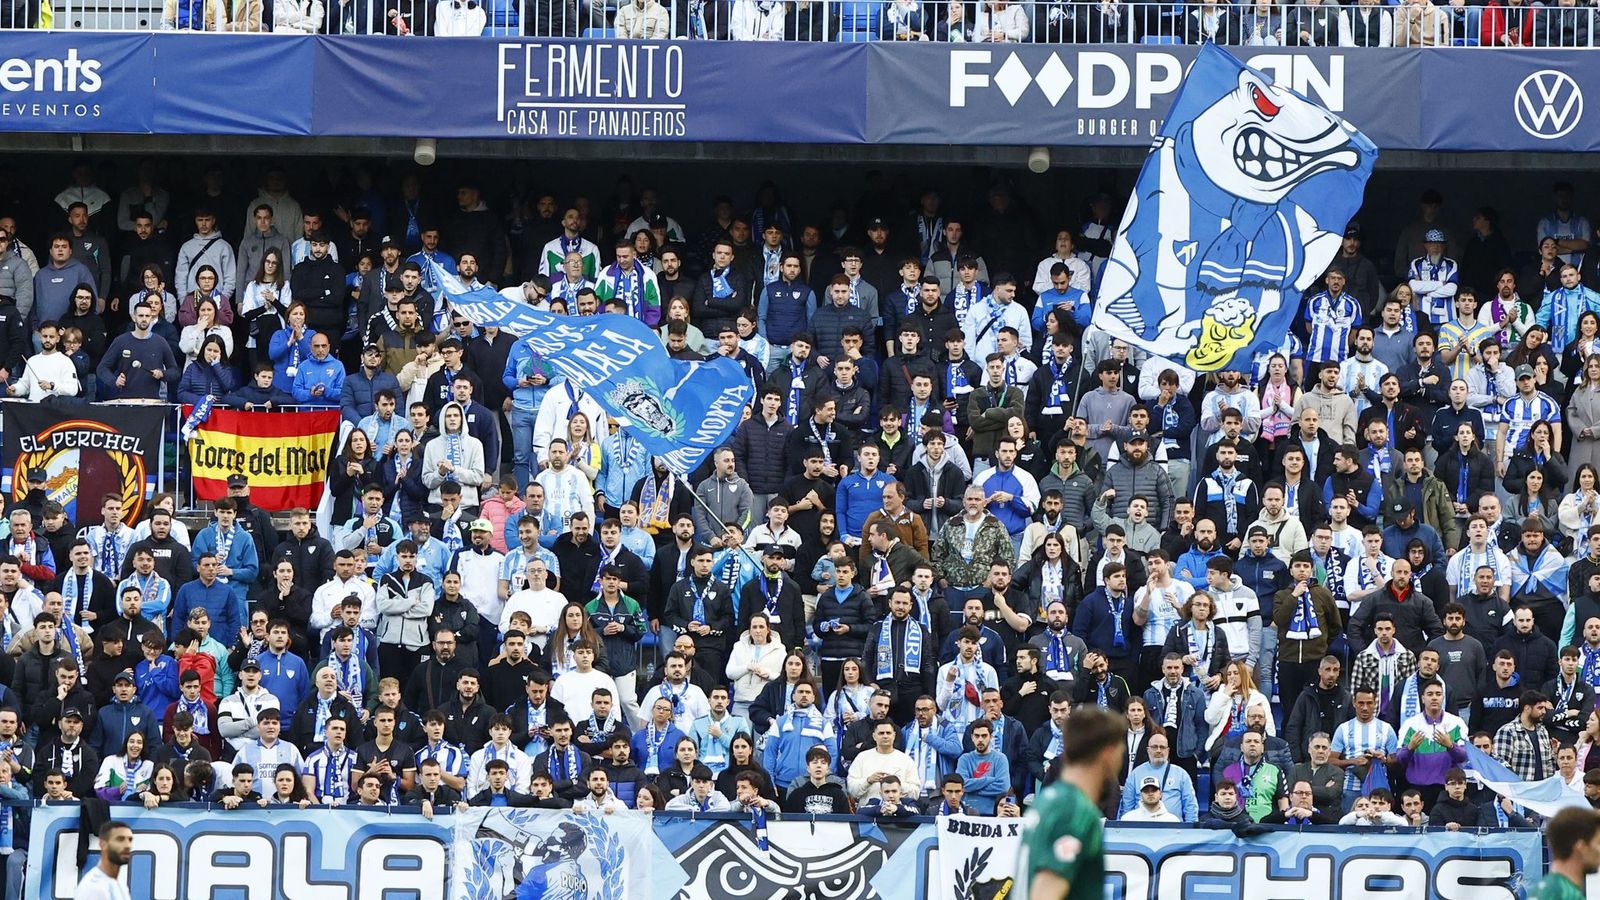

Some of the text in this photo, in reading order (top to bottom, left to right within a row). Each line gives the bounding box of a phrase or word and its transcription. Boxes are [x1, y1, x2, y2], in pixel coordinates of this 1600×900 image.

[0, 48, 102, 93] ents
[497, 43, 683, 122] FERMENTO
[2, 103, 100, 117] EVENTOS
[507, 110, 686, 137] CASA DE PANADEROS
[1077, 119, 1138, 136] BURGER
[20, 430, 145, 456] EL PERCHEL
[194, 439, 327, 477] Torre del Mar
[947, 818, 1019, 838] BREDA X
